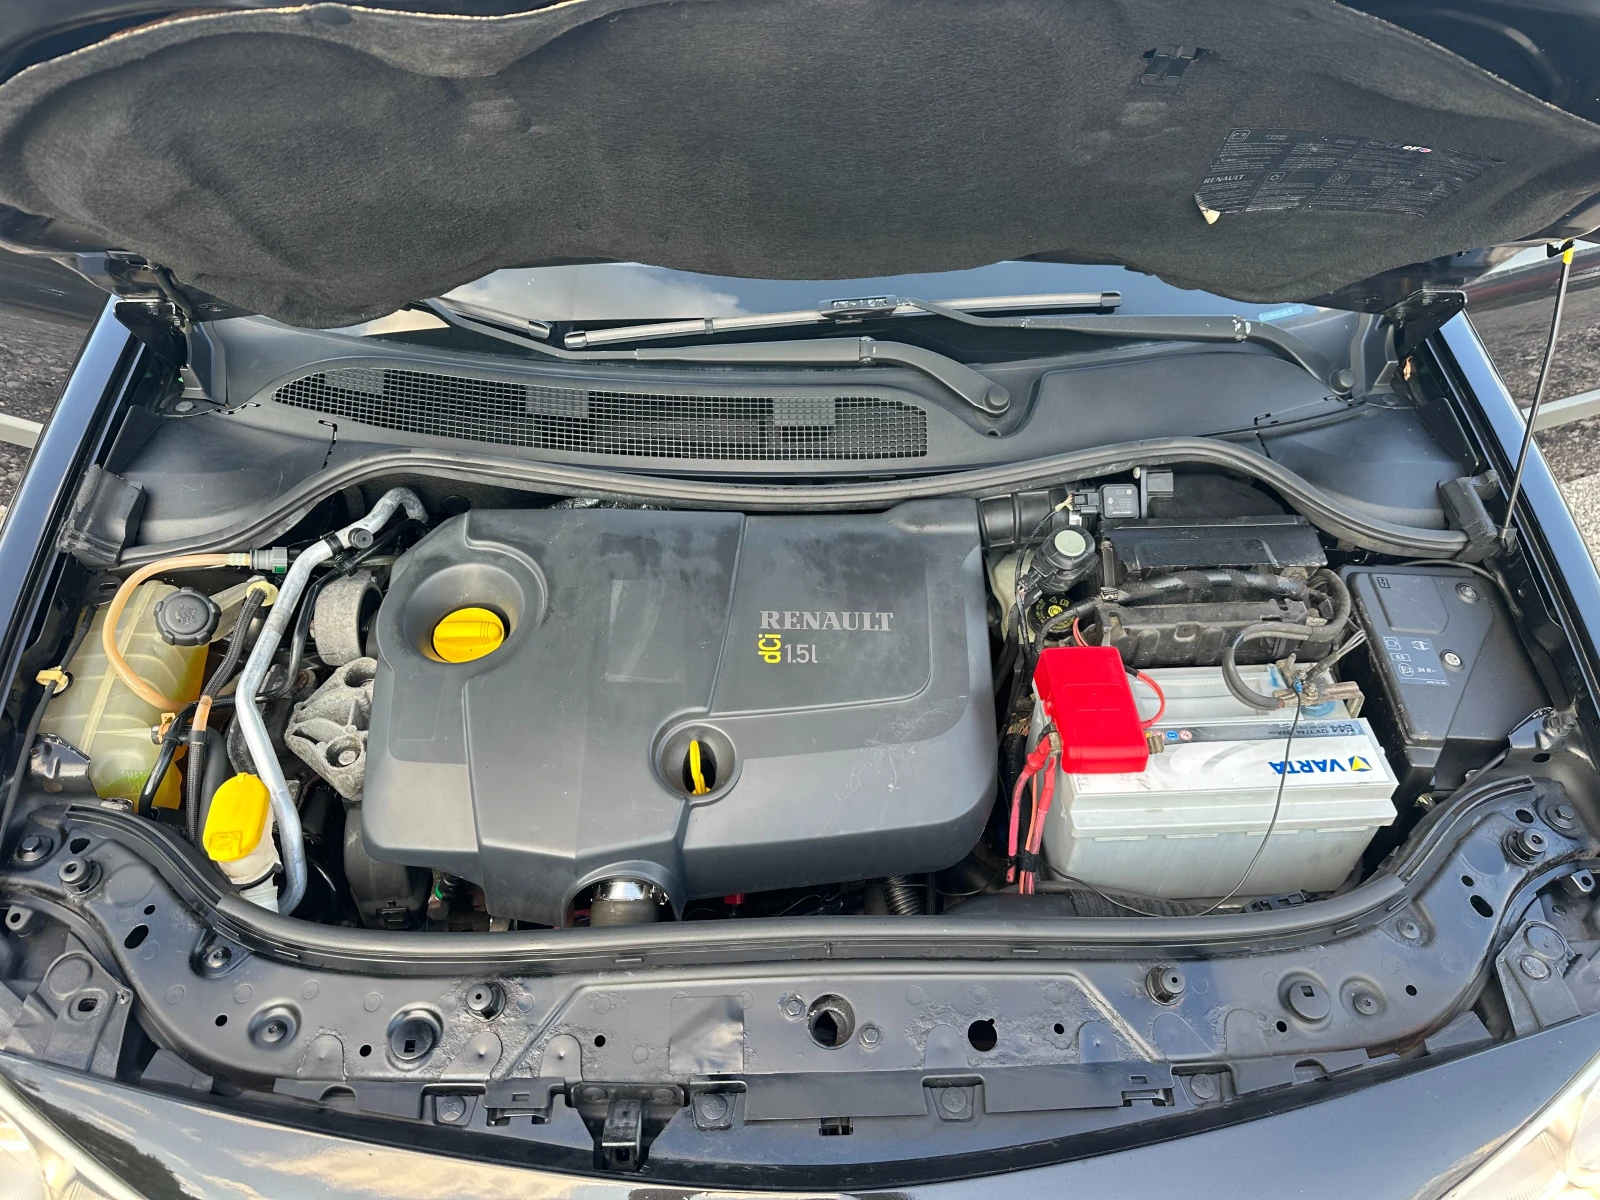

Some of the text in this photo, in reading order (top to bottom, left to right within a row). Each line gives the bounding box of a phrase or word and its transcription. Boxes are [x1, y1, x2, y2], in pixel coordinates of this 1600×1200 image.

[1203, 174, 1245, 185] RENAULT
[759, 610, 894, 632] RENAULT
[757, 633, 782, 665] dCi
[1267, 757, 1347, 775] VARTA
